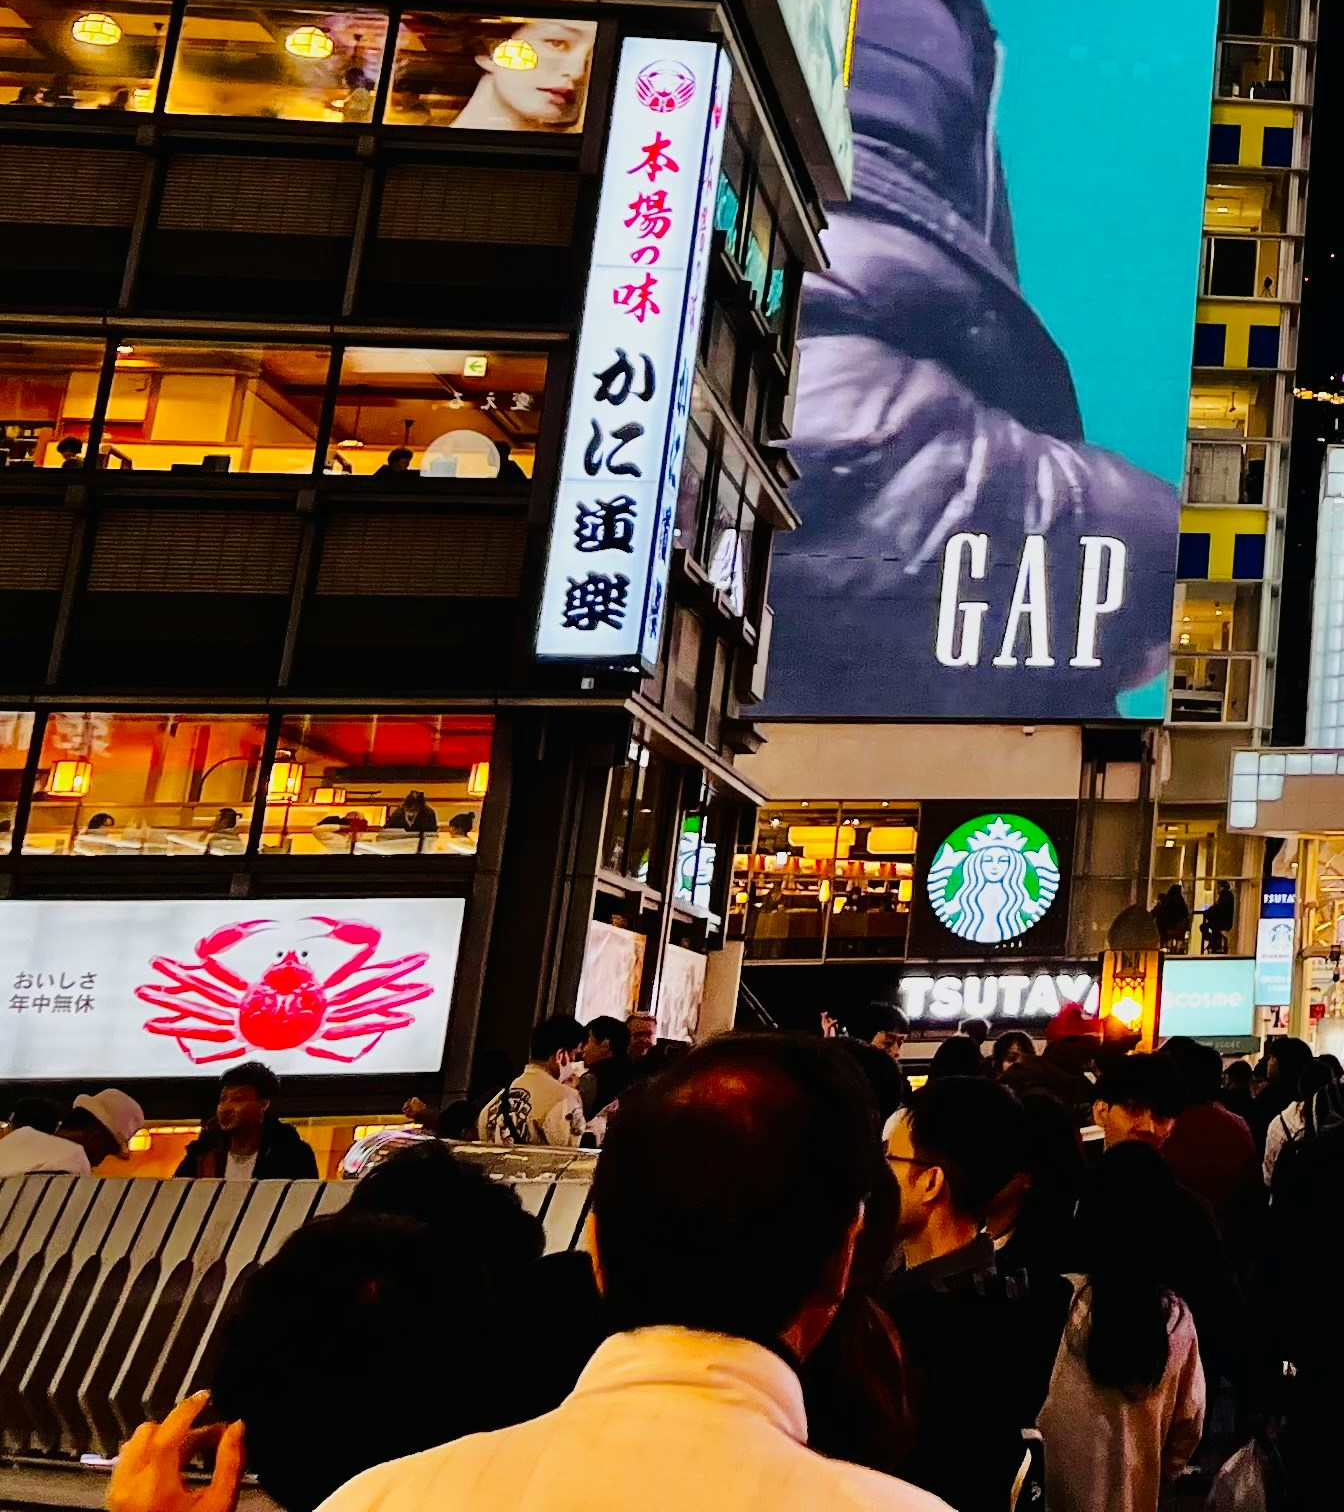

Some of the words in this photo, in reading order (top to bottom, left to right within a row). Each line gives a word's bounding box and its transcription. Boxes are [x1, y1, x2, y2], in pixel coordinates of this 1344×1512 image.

[612, 130, 682, 325] 本場の味
[935, 532, 1128, 667] GAP
[8, 993, 96, 1016] 年中無休
[13, 970, 98, 991] おいしさ
